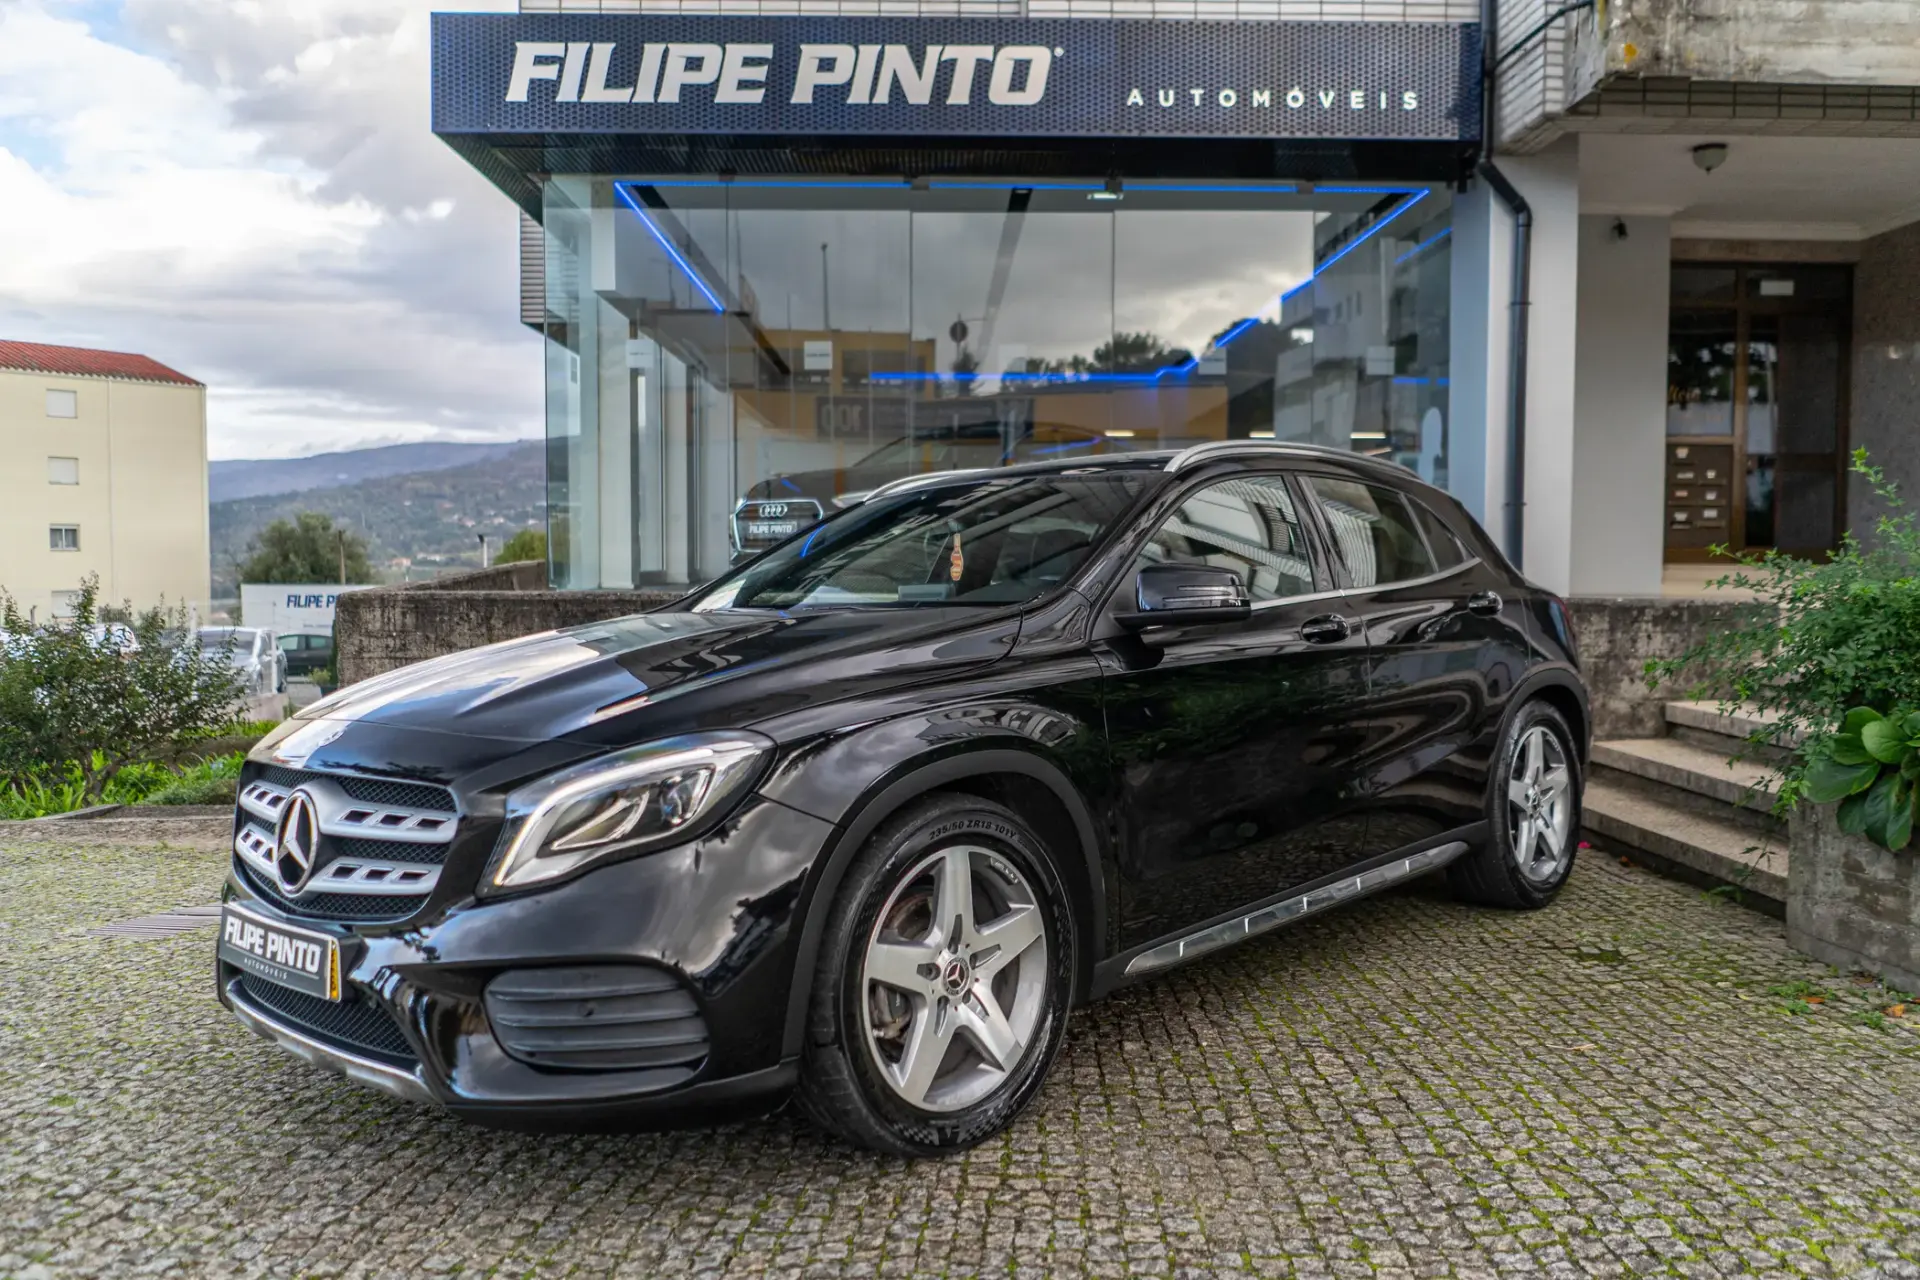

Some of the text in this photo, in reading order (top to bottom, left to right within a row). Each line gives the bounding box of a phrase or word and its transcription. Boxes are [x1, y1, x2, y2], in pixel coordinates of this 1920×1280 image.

[505, 41, 1052, 106] FILIPE PINTO
[1126, 85, 1418, 110] AUTOMÓVEIS
[287, 594, 323, 609] FILIPE
[928, 819, 1018, 840] 235/50 ZR18 101Y
[224, 914, 265, 956] FILIPE
[265, 931, 322, 974] PINTO
